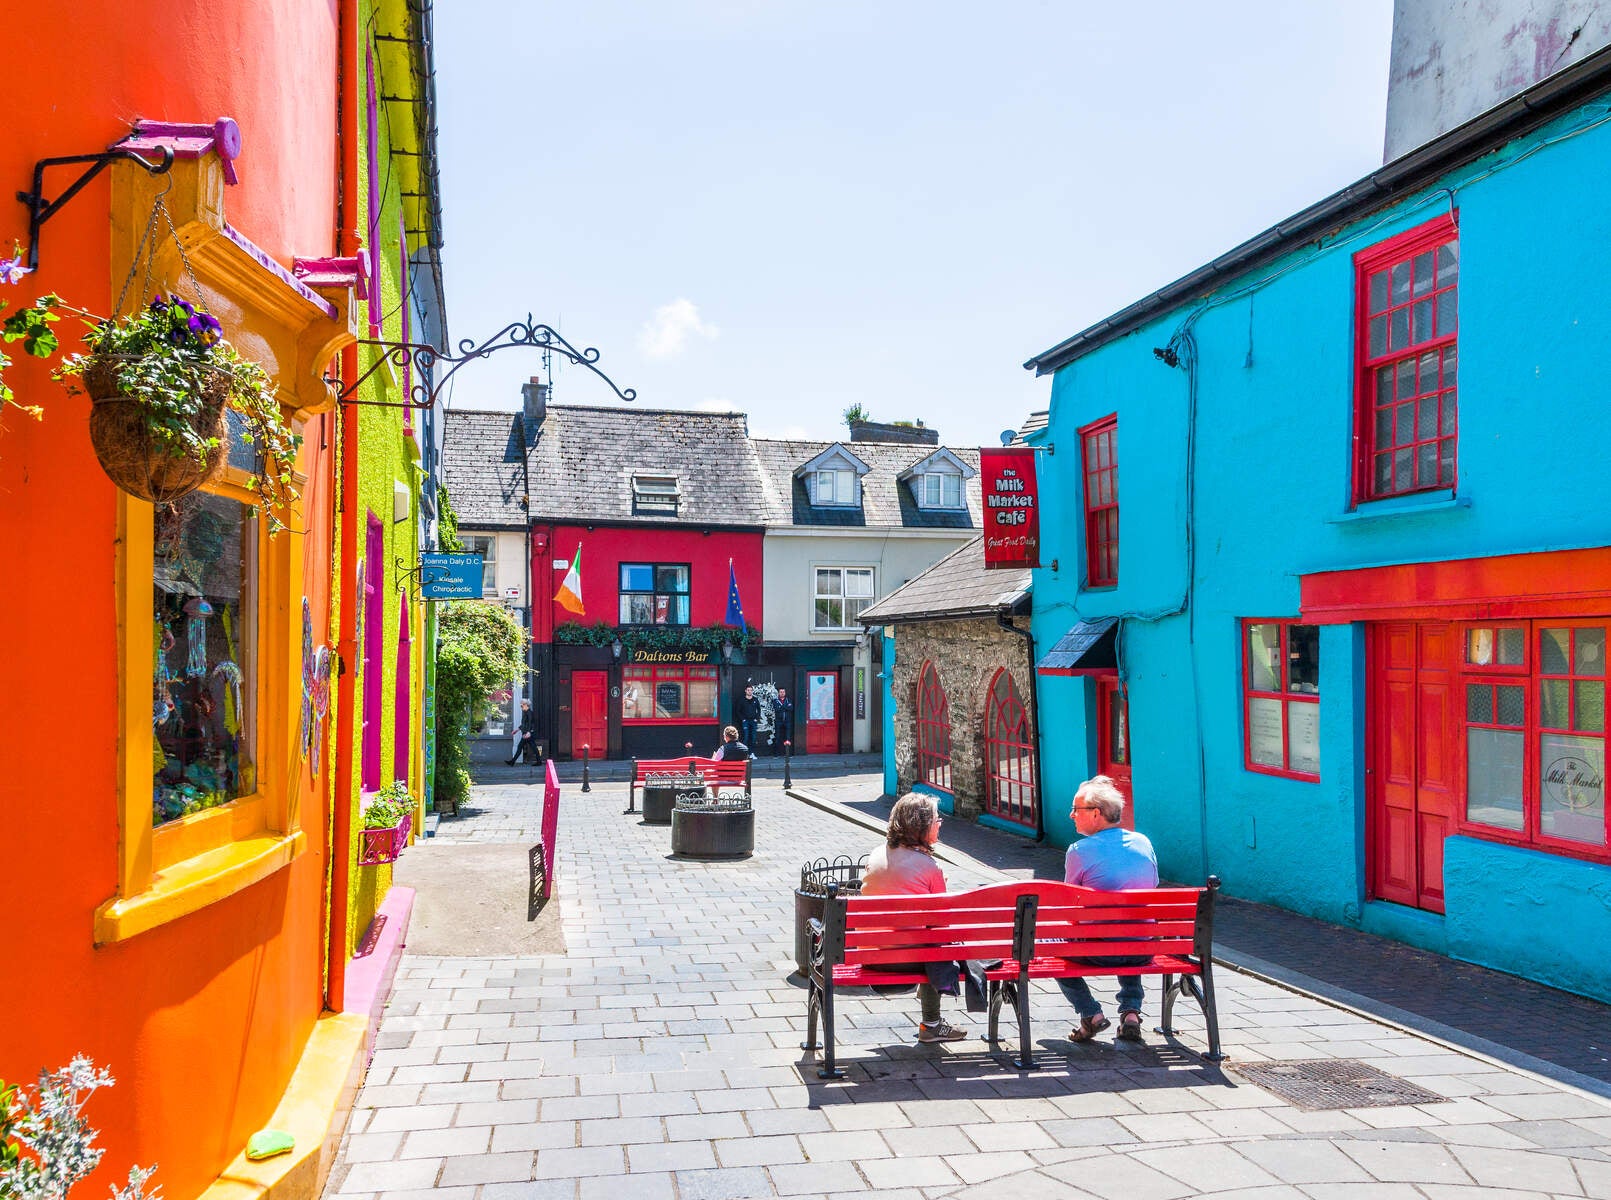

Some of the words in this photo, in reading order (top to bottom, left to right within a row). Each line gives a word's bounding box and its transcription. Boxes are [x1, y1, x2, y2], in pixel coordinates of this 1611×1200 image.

[1003, 468, 1016, 477] the
[995, 479, 1025, 492] Milk
[987, 494, 1034, 508] Market
[996, 510, 1026, 526] Café
[988, 536, 1004, 550] Great
[1004, 536, 1019, 548] Food
[1019, 535, 1036, 548] Daily
[449, 558, 465, 566] Daly
[432, 585, 473, 593] Chiropractic
[634, 650, 682, 662] Daltons
[685, 651, 709, 662] Bar
[1543, 769, 1568, 785] Milk
[1568, 771, 1603, 789] Market
